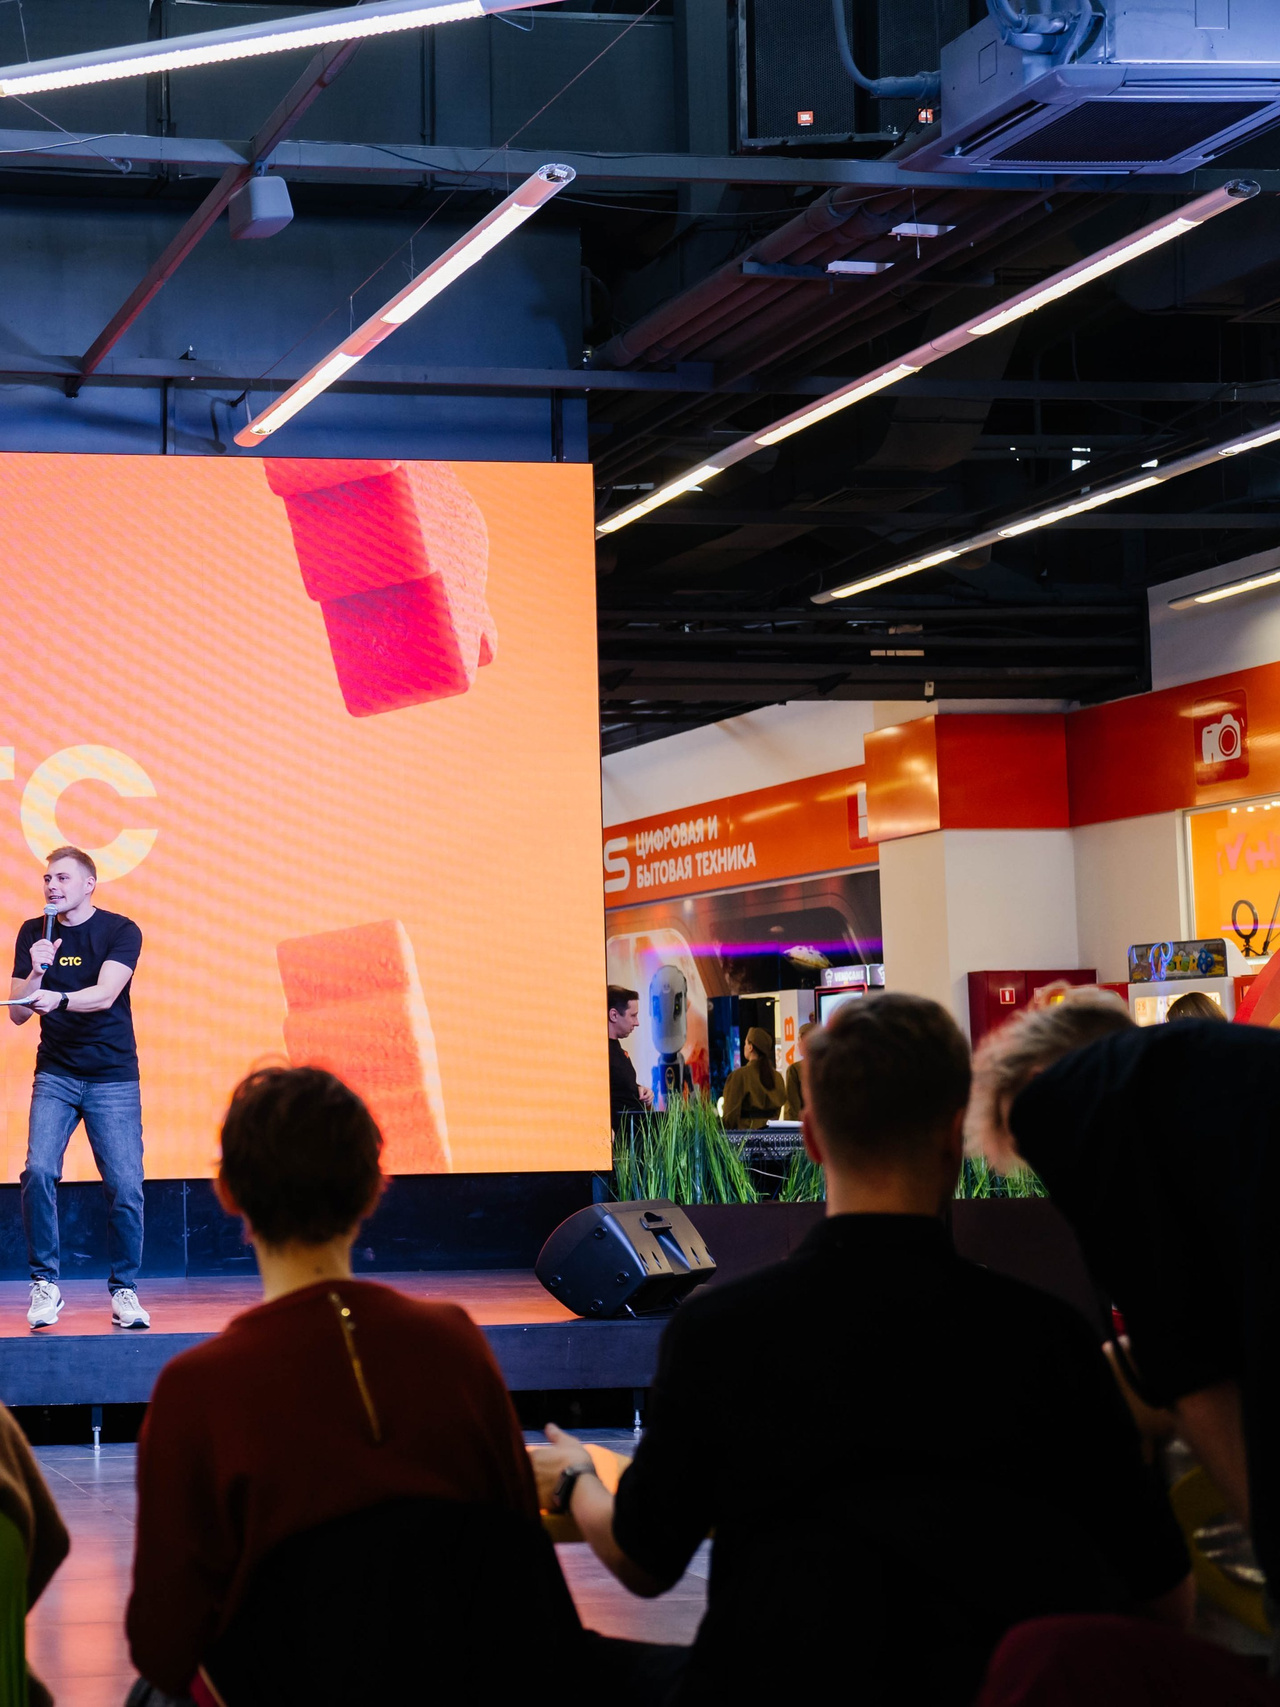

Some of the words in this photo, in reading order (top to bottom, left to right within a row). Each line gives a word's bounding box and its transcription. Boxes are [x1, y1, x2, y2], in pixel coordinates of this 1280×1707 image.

[635, 818, 704, 860] ЦИФРОВАЯ
[707, 814, 718, 840] И
[636, 854, 692, 889] БЫТОВАЯ
[695, 841, 757, 877] ТЕХНИКА
[59, 956, 82, 966] СТС
